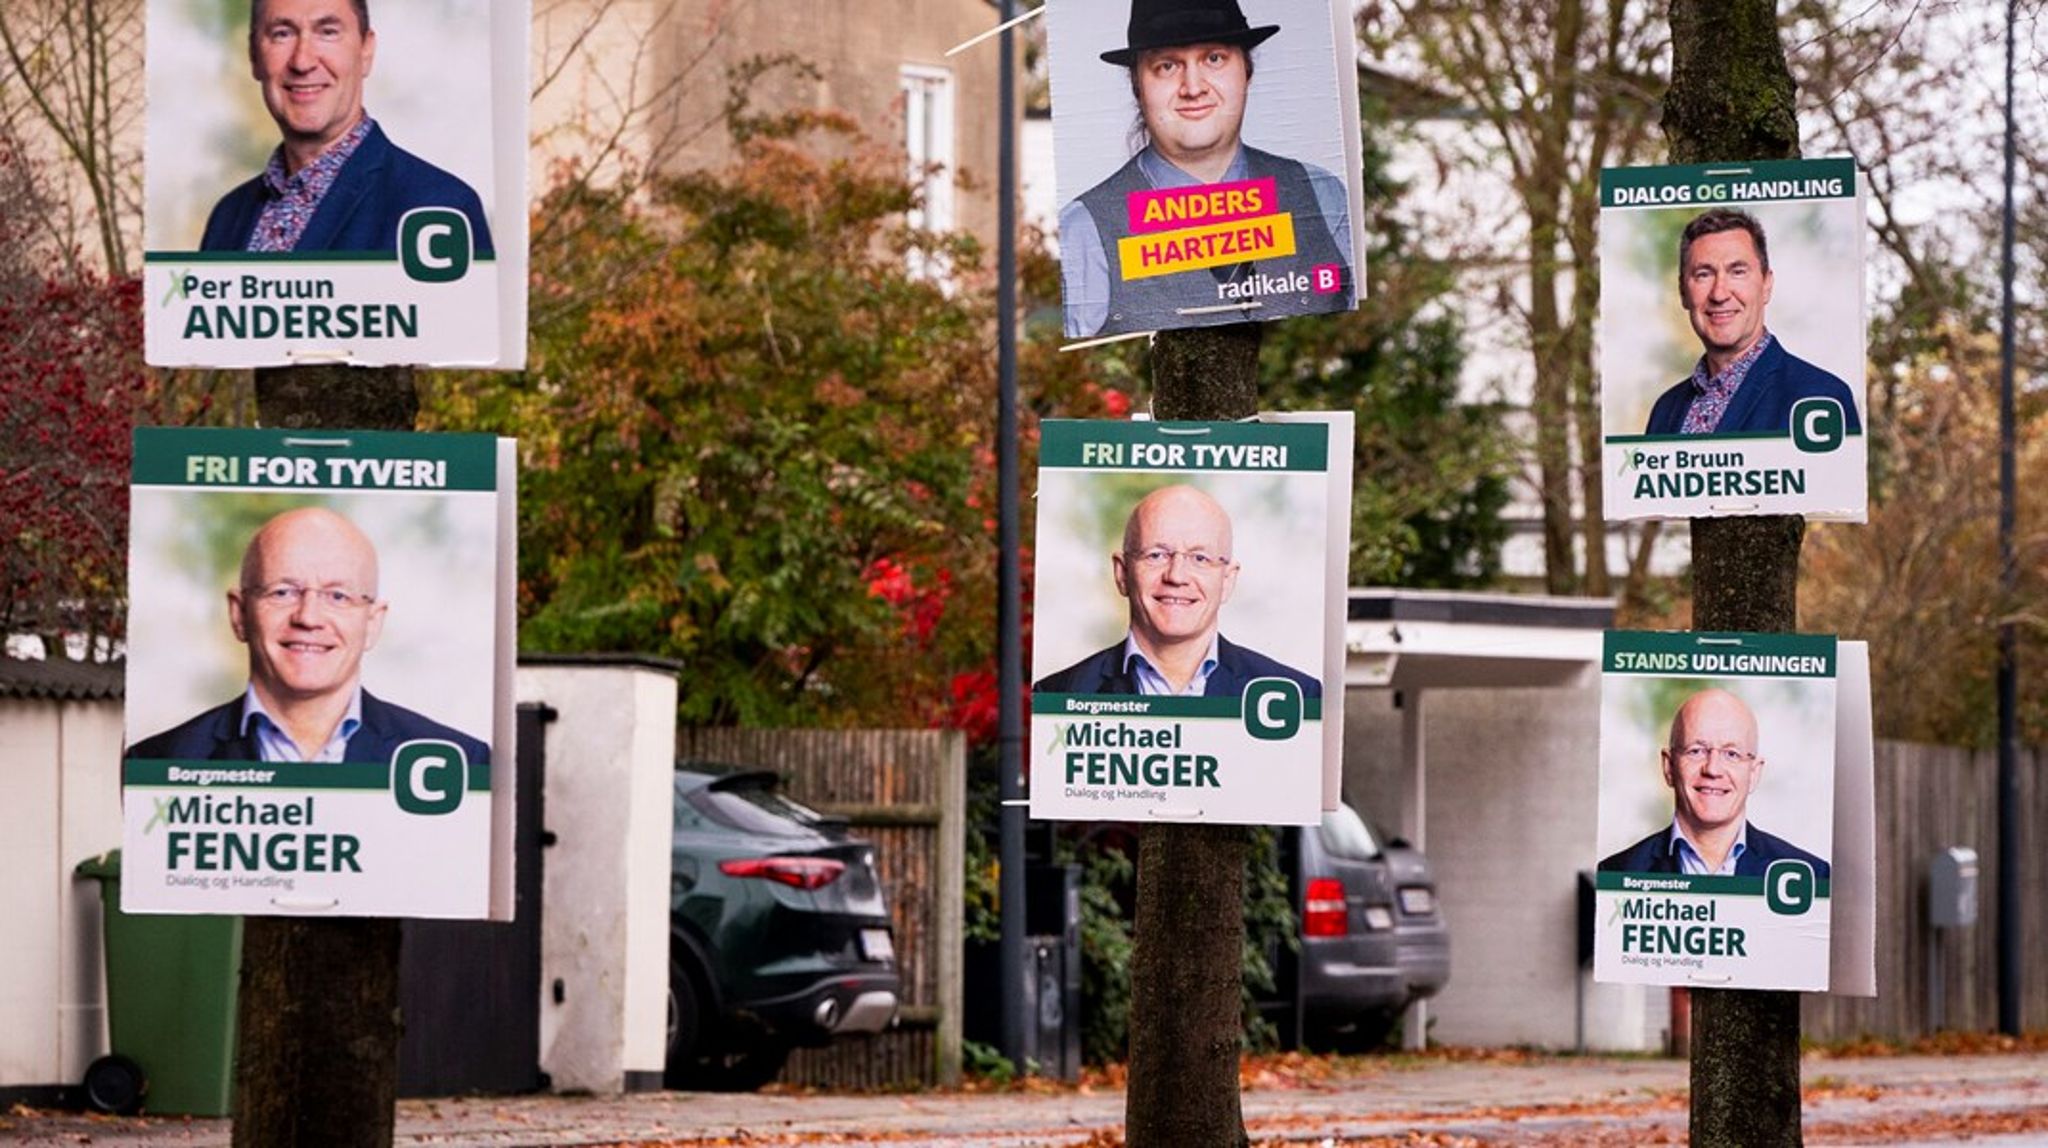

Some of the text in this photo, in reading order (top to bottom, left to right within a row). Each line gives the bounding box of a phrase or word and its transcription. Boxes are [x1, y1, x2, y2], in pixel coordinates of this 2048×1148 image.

[1143, 187, 1263, 223] ANDERS
[1614, 178, 1843, 204] DIALOG OG HANDLING
[416, 222, 452, 268] C
[1140, 225, 1274, 267] HARTZEN
[183, 274, 334, 300] Per Bruun
[1217, 269, 1335, 299] radikale B
[183, 303, 418, 339] ANDERSEN
[1804, 409, 1831, 443] C
[186, 454, 447, 487] FRI FOR TYVERI
[1082, 443, 1287, 468] FRI FOR TYVERI
[1633, 451, 1744, 469] Per Bruun
[1634, 468, 1806, 499] ANDERSEN
[1614, 652, 1827, 673] STANDS UDLIGNINGEN
[1066, 699, 1150, 714] Borgmester
[1256, 691, 1287, 729] C
[1066, 722, 1181, 749] Michael
[168, 766, 276, 786] Borgmester
[409, 756, 447, 801] C
[1065, 752, 1221, 787] FENGER
[1065, 787, 1167, 801] Dialog og Handling
[168, 796, 314, 826] Michael
[167, 831, 363, 873] FENGER
[166, 873, 295, 890] Dialog og Handling
[1622, 877, 1691, 890] Borgmester
[1777, 872, 1802, 905] C
[1623, 898, 1716, 922] Michael
[1622, 924, 1747, 957] FENGER
[1621, 955, 1704, 969] Dialog og Handling
